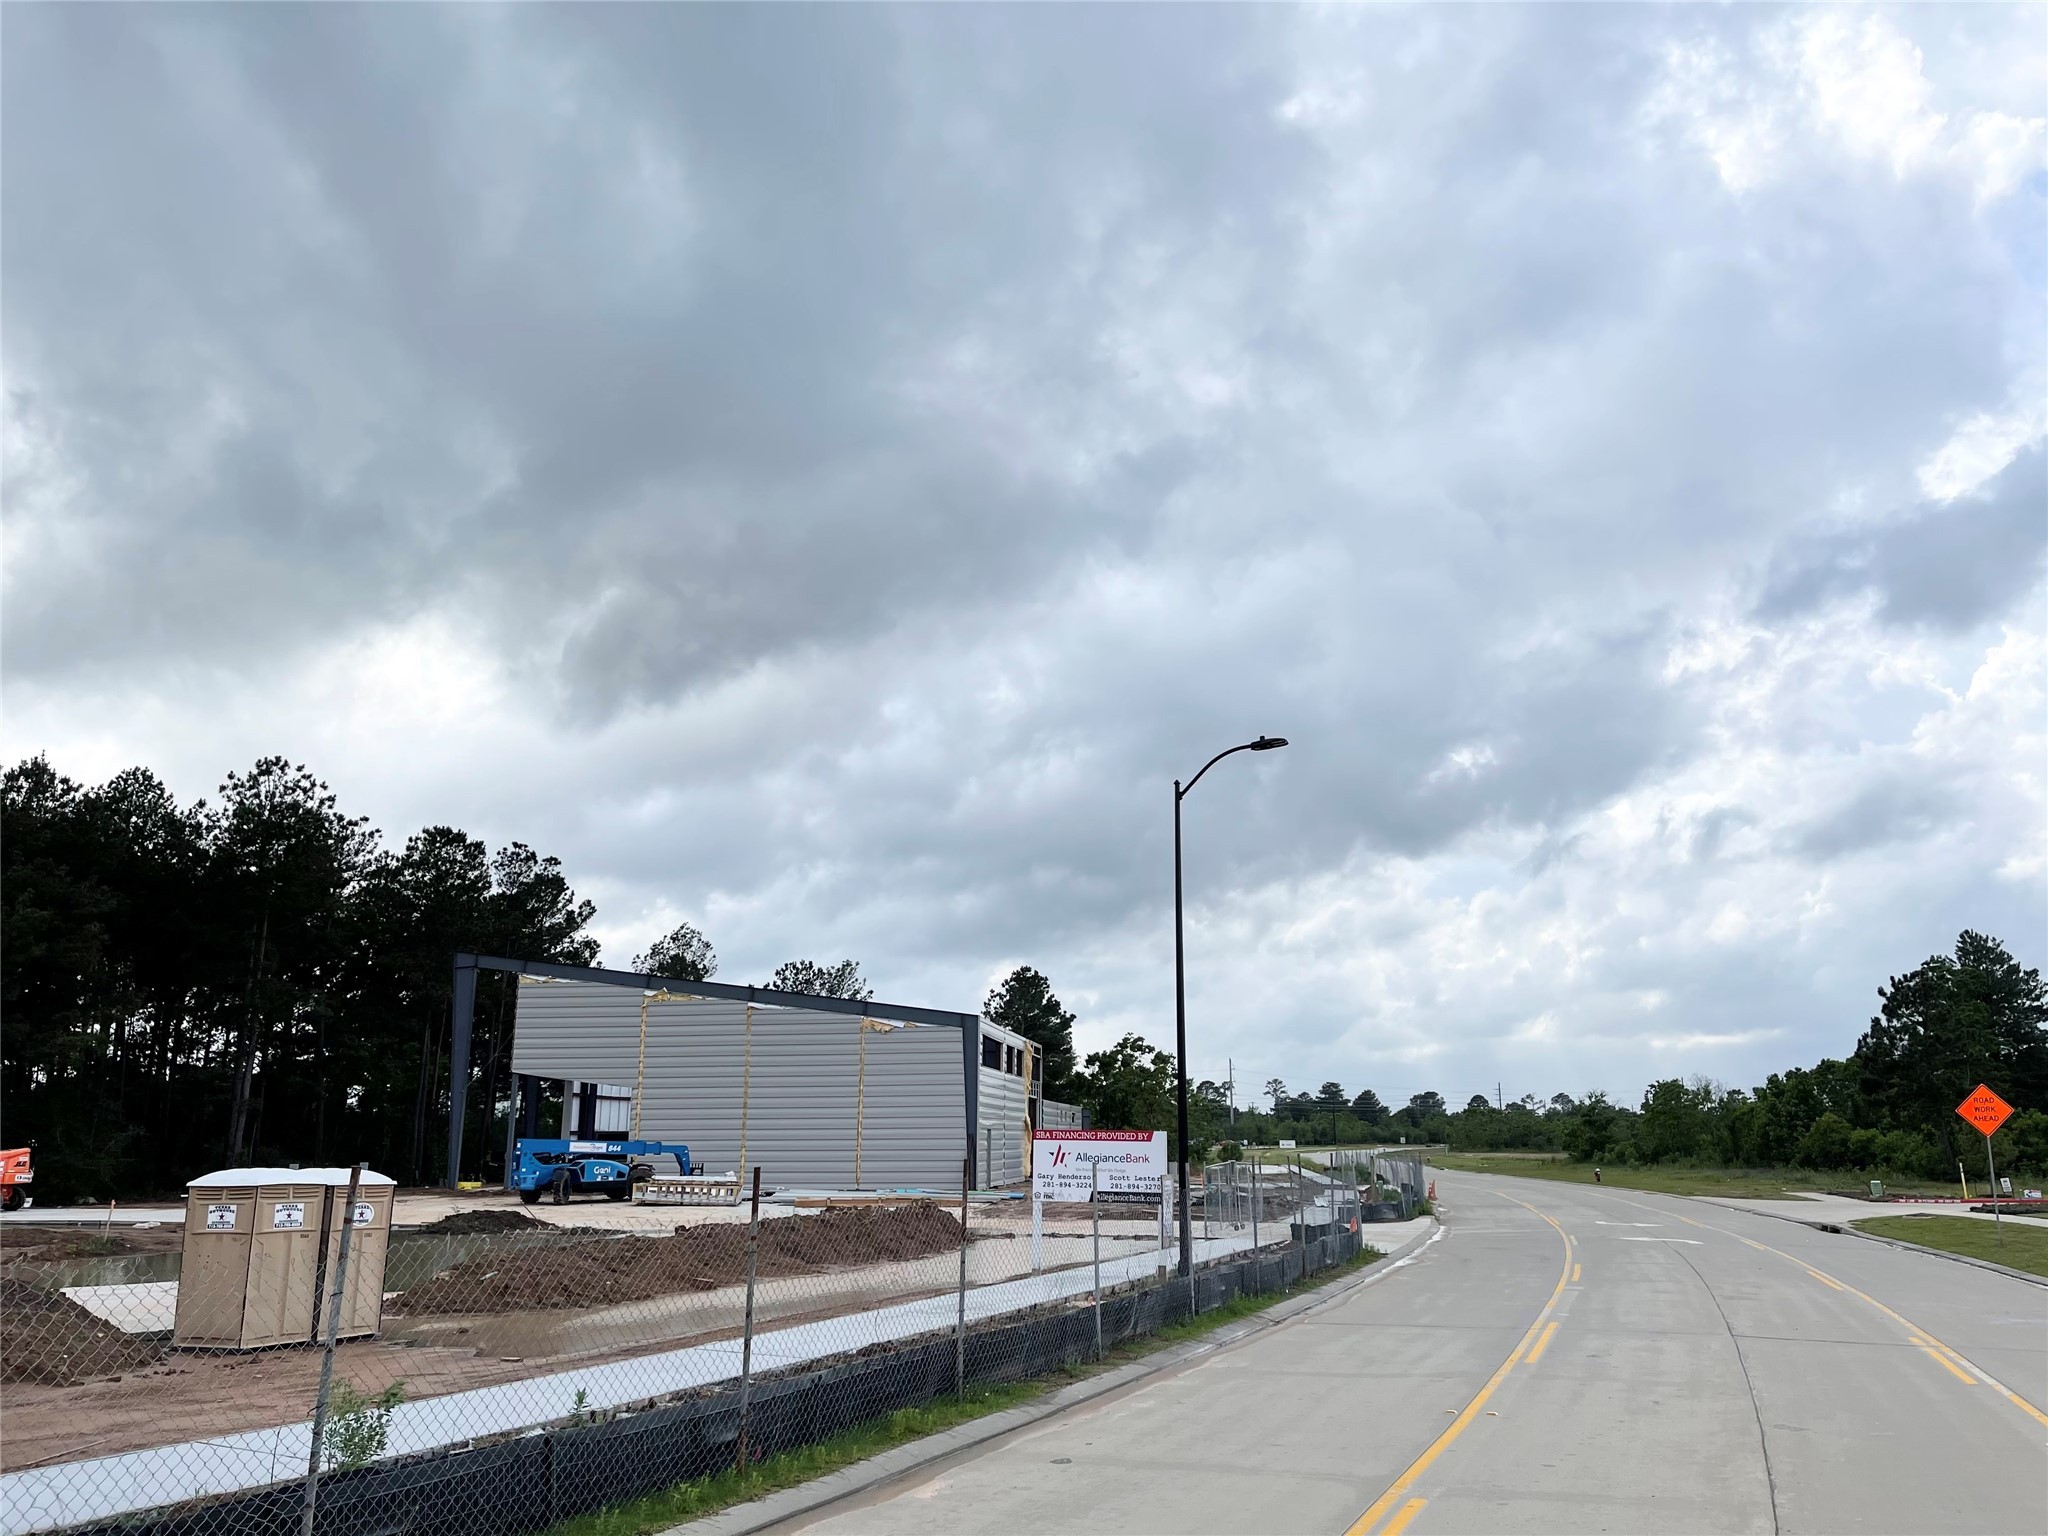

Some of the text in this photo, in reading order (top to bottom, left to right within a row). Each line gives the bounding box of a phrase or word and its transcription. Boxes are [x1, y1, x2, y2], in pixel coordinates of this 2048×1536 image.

[1036, 1131, 1149, 1141] SBA FINANCING PROVIDED BY
[1075, 1152, 1150, 1164] AllegianceBank
[1042, 1181, 1092, 1189] 281-894-3224
[1110, 1182, 1161, 1190] 281-894-3270
